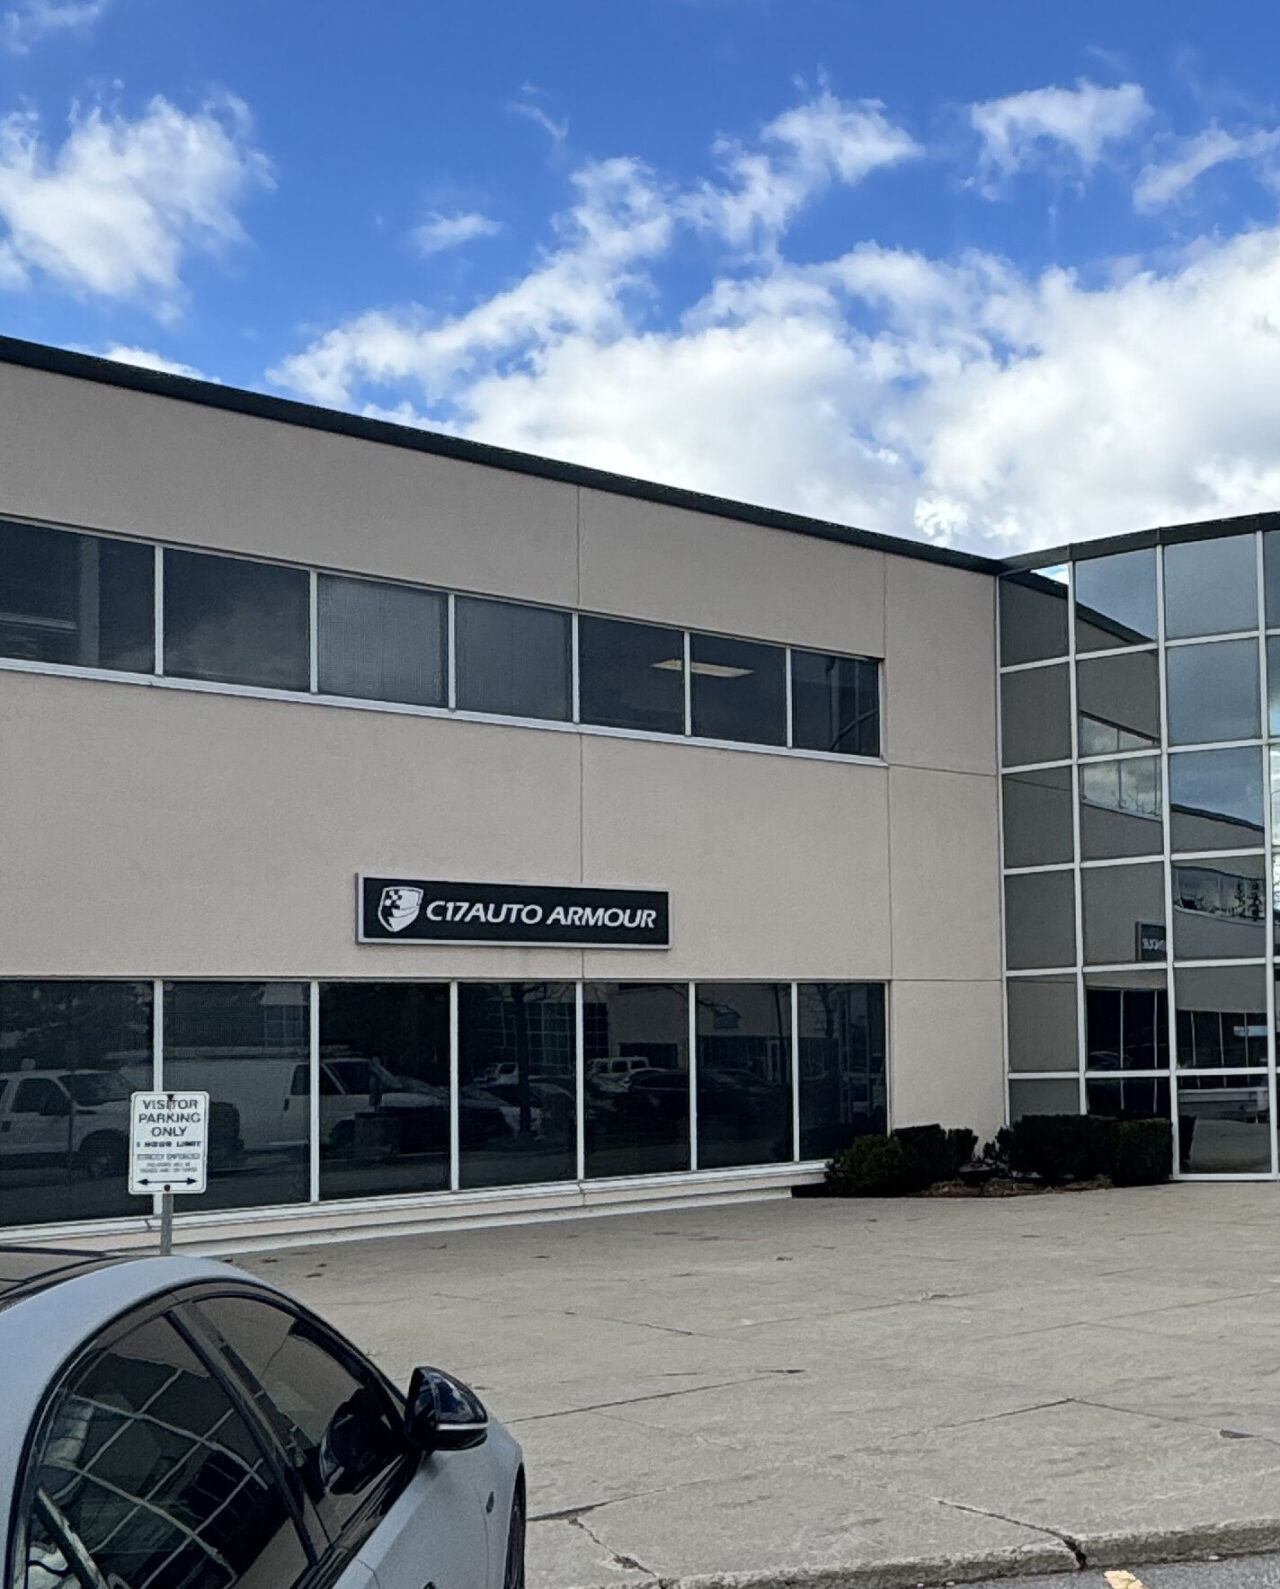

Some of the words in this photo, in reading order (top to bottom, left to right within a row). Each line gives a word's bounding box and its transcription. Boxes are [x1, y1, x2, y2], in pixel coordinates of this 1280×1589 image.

[425, 899, 543, 924] C17AUTO
[546, 905, 657, 929] ARMOUR
[142, 1099, 199, 1110] VISITOR
[138, 1112, 201, 1123] PARKING
[151, 1126, 188, 1137] ONLY
